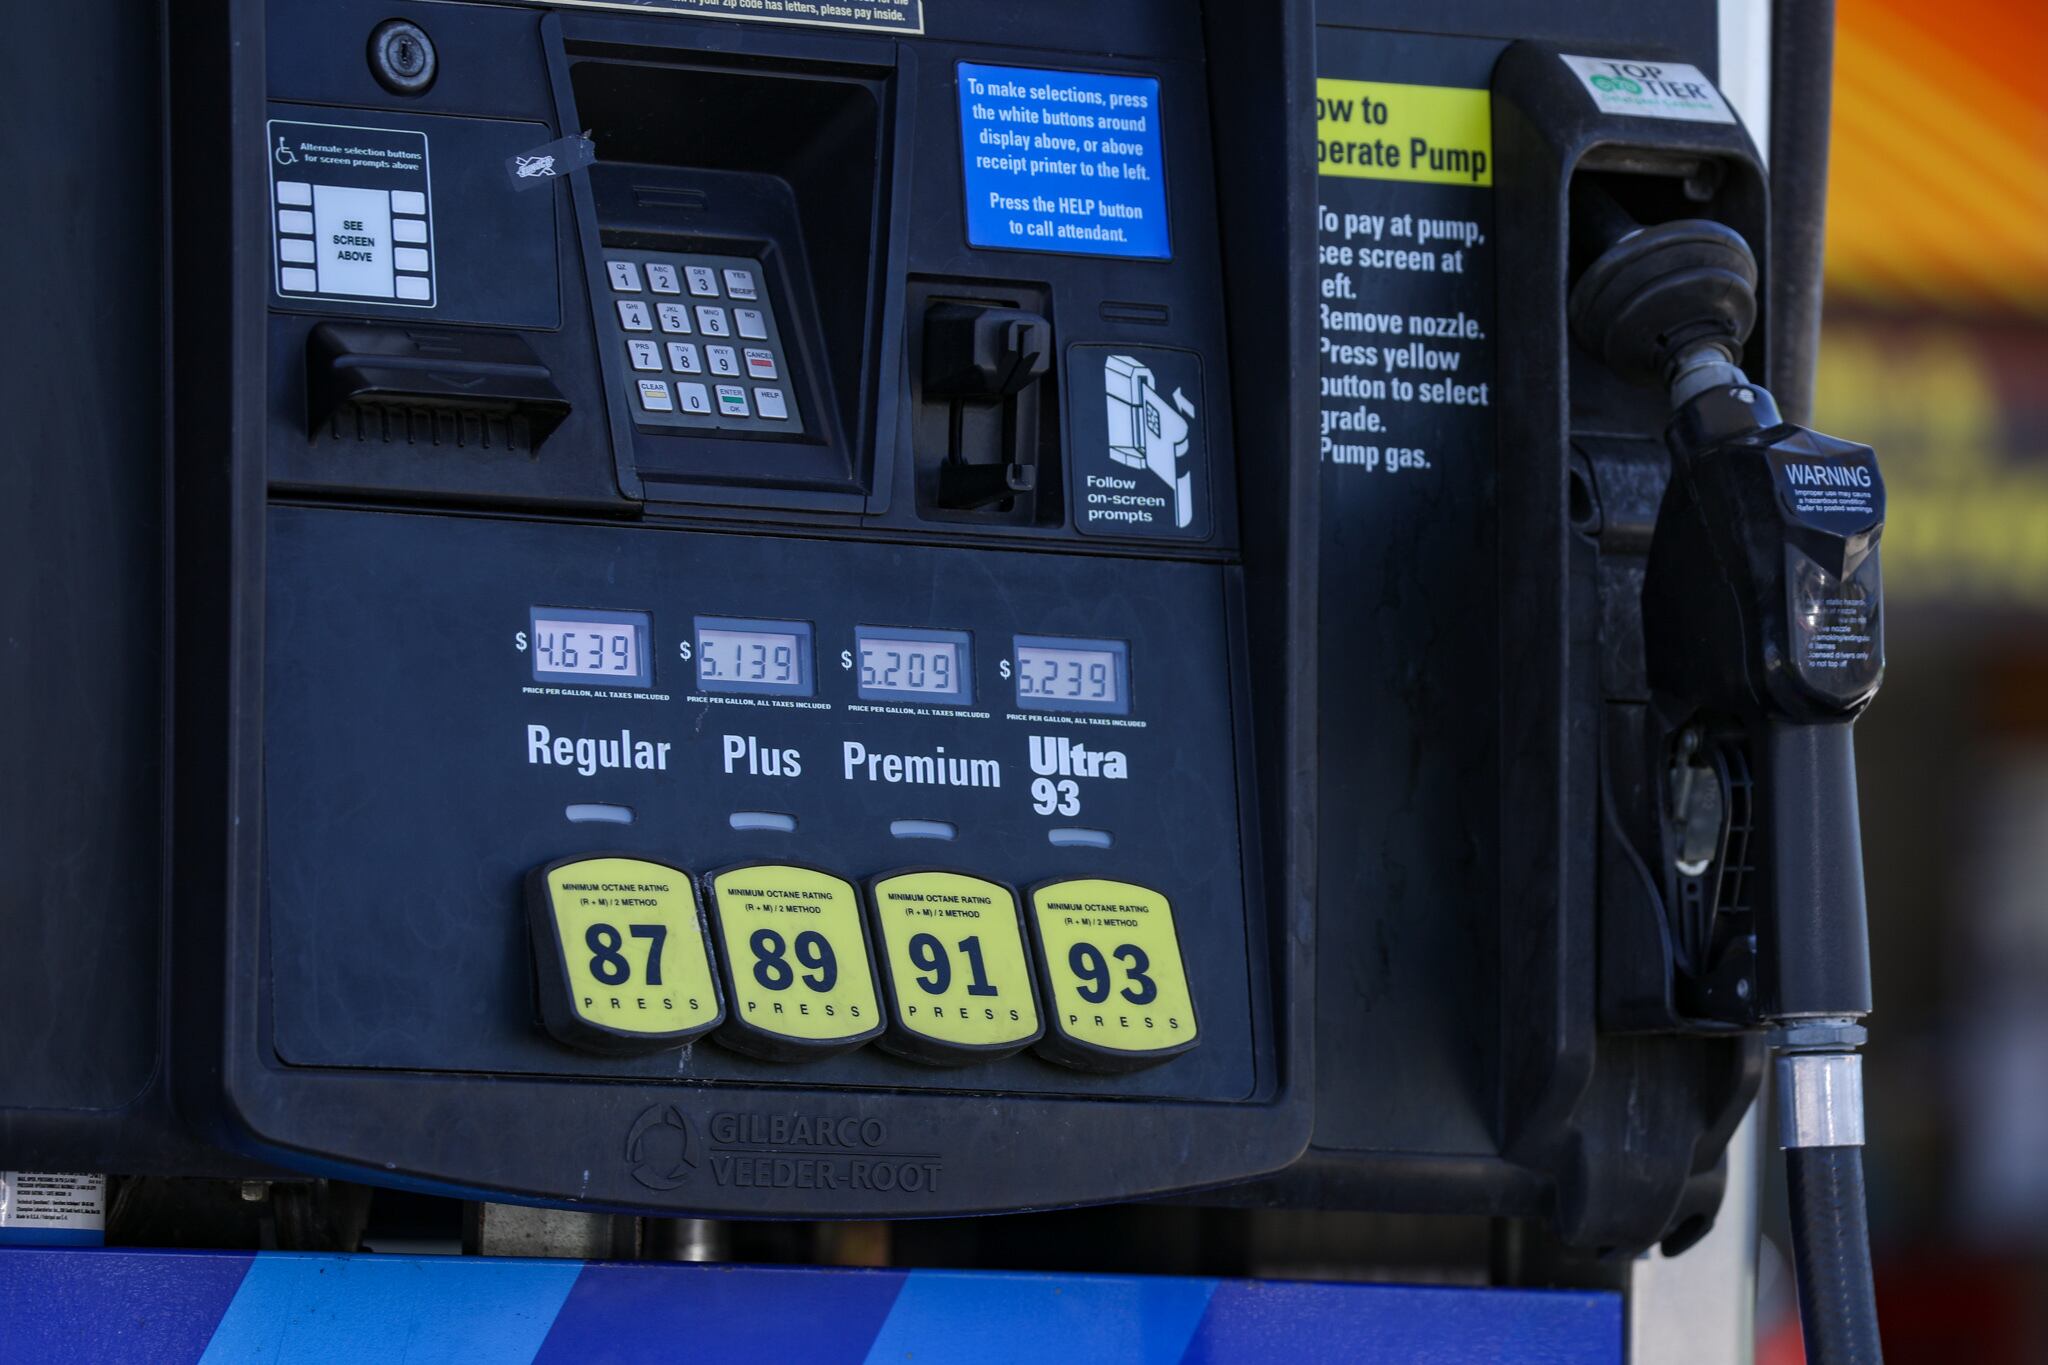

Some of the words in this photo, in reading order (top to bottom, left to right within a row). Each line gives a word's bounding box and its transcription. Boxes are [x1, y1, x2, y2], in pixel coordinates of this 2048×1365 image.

[740, 0, 763, 9] code
[765, 0, 783, 11] has
[785, 0, 819, 15] letters,
[821, 4, 852, 16] please
[854, 8, 872, 20] pay
[873, 8, 906, 21] inside.
[1601, 62, 1663, 80] TOP
[967, 77, 985, 95] To
[988, 81, 1026, 99] make
[1030, 84, 1107, 106] selections,
[1109, 93, 1148, 110] press
[1638, 78, 1708, 99] TIER
[972, 104, 995, 121] the
[999, 106, 1039, 124] white
[1043, 109, 1095, 128] buttons
[1098, 116, 1146, 132] around
[1316, 97, 1353, 122] ow
[1361, 96, 1388, 125] to
[979, 128, 1030, 151] display
[1034, 132, 1080, 153] above,
[1083, 140, 1098, 152] or
[1101, 138, 1144, 156] above
[300, 143, 342, 153] Alternate
[344, 147, 386, 157] selection
[387, 150, 422, 160] buttons
[1410, 137, 1487, 182] Pump
[305, 154, 318, 162] for
[320, 156, 351, 164] screen
[353, 159, 390, 168] prompts
[392, 162, 419, 170] above
[976, 154, 1027, 175] receipt
[1030, 157, 1076, 176] printer
[1080, 163, 1095, 177] to
[1097, 161, 1120, 179] the
[1123, 163, 1151, 181] left.
[989, 191, 1030, 211] Press
[1033, 196, 1055, 213] the
[1059, 197, 1095, 216] HELP
[1099, 200, 1143, 220] button
[343, 220, 364, 231] SEE
[1008, 220, 1023, 235] to
[1026, 220, 1054, 237] call
[1057, 223, 1128, 243] attendant.
[1344, 213, 1385, 241] pay
[1390, 213, 1413, 237] at
[1417, 218, 1485, 248] pump,
[333, 235, 375, 247] SCREEN
[337, 251, 373, 262] ABOVE
[1358, 247, 1435, 272] screen
[1441, 250, 1464, 273] at
[620, 274, 629, 286] 1
[659, 276, 670, 289] 2
[699, 279, 709, 291] 3
[631, 313, 641, 326] 4
[671, 316, 680, 328] 5
[710, 319, 719, 332] 6
[1409, 312, 1486, 340] nozzle.
[640, 353, 649, 365] 7
[681, 356, 690, 369] 8
[719, 359, 729, 371] 9
[1383, 342, 1461, 374] yellow
[641, 383, 664, 391] CLEAR
[719, 388, 742, 396] ENTER
[761, 391, 779, 399] HELP
[1391, 377, 1414, 401] to
[1418, 377, 1489, 406] select
[691, 396, 700, 409] 0
[730, 405, 740, 413] OK
[1385, 446, 1431, 473] gas.
[1087, 475, 1136, 489] Follow
[1785, 463, 1872, 487] WARNING
[1088, 493, 1165, 507] on-screen
[1088, 509, 1153, 524] prompts
[515, 631, 527, 652] $
[538, 632, 629, 670] 4.639
[680, 640, 691, 661] $
[701, 641, 791, 681] 5.139
[841, 650, 852, 671] $
[1000, 659, 1011, 679] $
[562, 689, 592, 697] GALLON,
[609, 691, 632, 699] TAXES
[633, 693, 670, 701] INCLUDED
[725, 698, 756, 706] GALLON,
[796, 702, 832, 710] INCLUDED
[886, 707, 916, 715] GALLON,
[932, 709, 953, 717] TAXES
[527, 724, 671, 776] Regular
[722, 734, 802, 778] Plus
[1028, 735, 1128, 779] Ultra
[843, 741, 1000, 788] Premium
[1031, 777, 1081, 817] 93
[638, 884, 669, 892] RATING
[728, 888, 765, 897] MINIMUM
[766, 890, 800, 898] OCTANE
[802, 891, 833, 900] RATING
[888, 893, 924, 901] MINIMUM
[926, 895, 959, 903] OCTANE
[962, 896, 991, 904] RATING
[786, 905, 821, 913] METHOD
[945, 910, 980, 918] METHOD
[1047, 903, 1082, 911] MINIMUM
[1085, 904, 1117, 912] OCTANE
[1119, 905, 1149, 913] RATING
[1104, 919, 1138, 927] METHOD
[585, 923, 668, 986] 87
[750, 928, 838, 993] 89
[908, 932, 998, 997] 91
[1068, 942, 1158, 1006] 93
[584, 997, 699, 1011] PRESS
[748, 1001, 860, 1017] PRESS
[908, 1006, 1019, 1021] PRESS
[1069, 1014, 1178, 1030] PRESS
[709, 1112, 888, 1148] GILBARCO
[709, 1157, 943, 1192] VEEDER-ROOT
